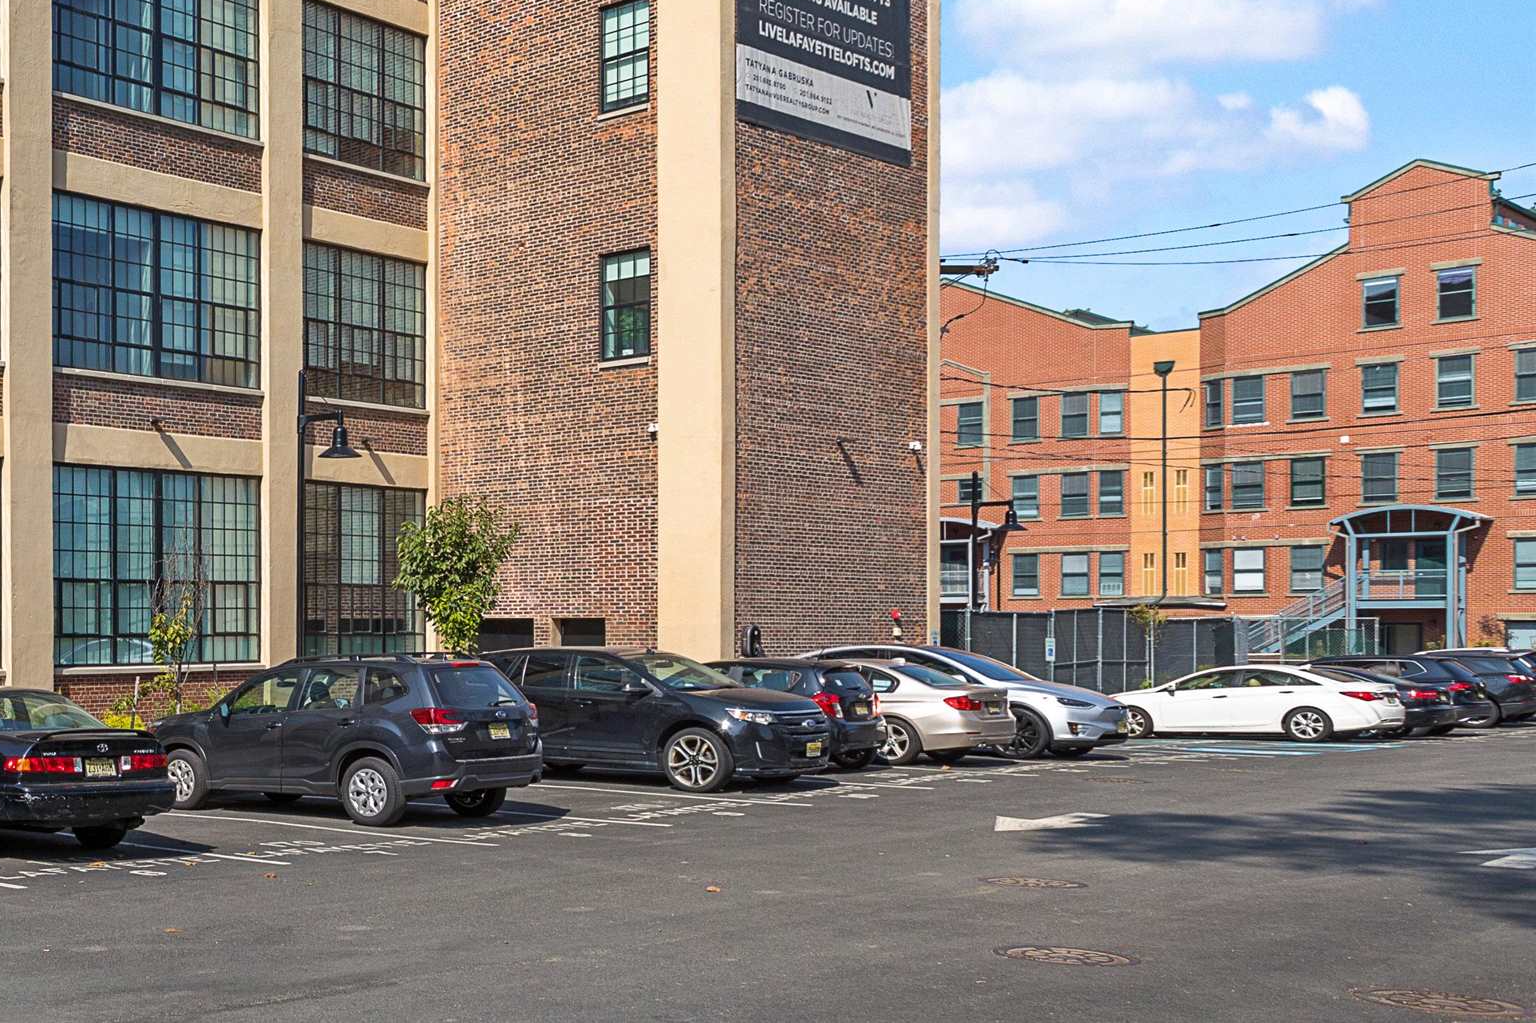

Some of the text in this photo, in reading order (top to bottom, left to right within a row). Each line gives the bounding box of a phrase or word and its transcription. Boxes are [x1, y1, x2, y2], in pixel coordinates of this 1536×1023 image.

[817, 17, 840, 42] FOR
[758, 19, 895, 80] LIVELAFAYETTELOFTS.COM
[745, 57, 777, 75] TATYANA
